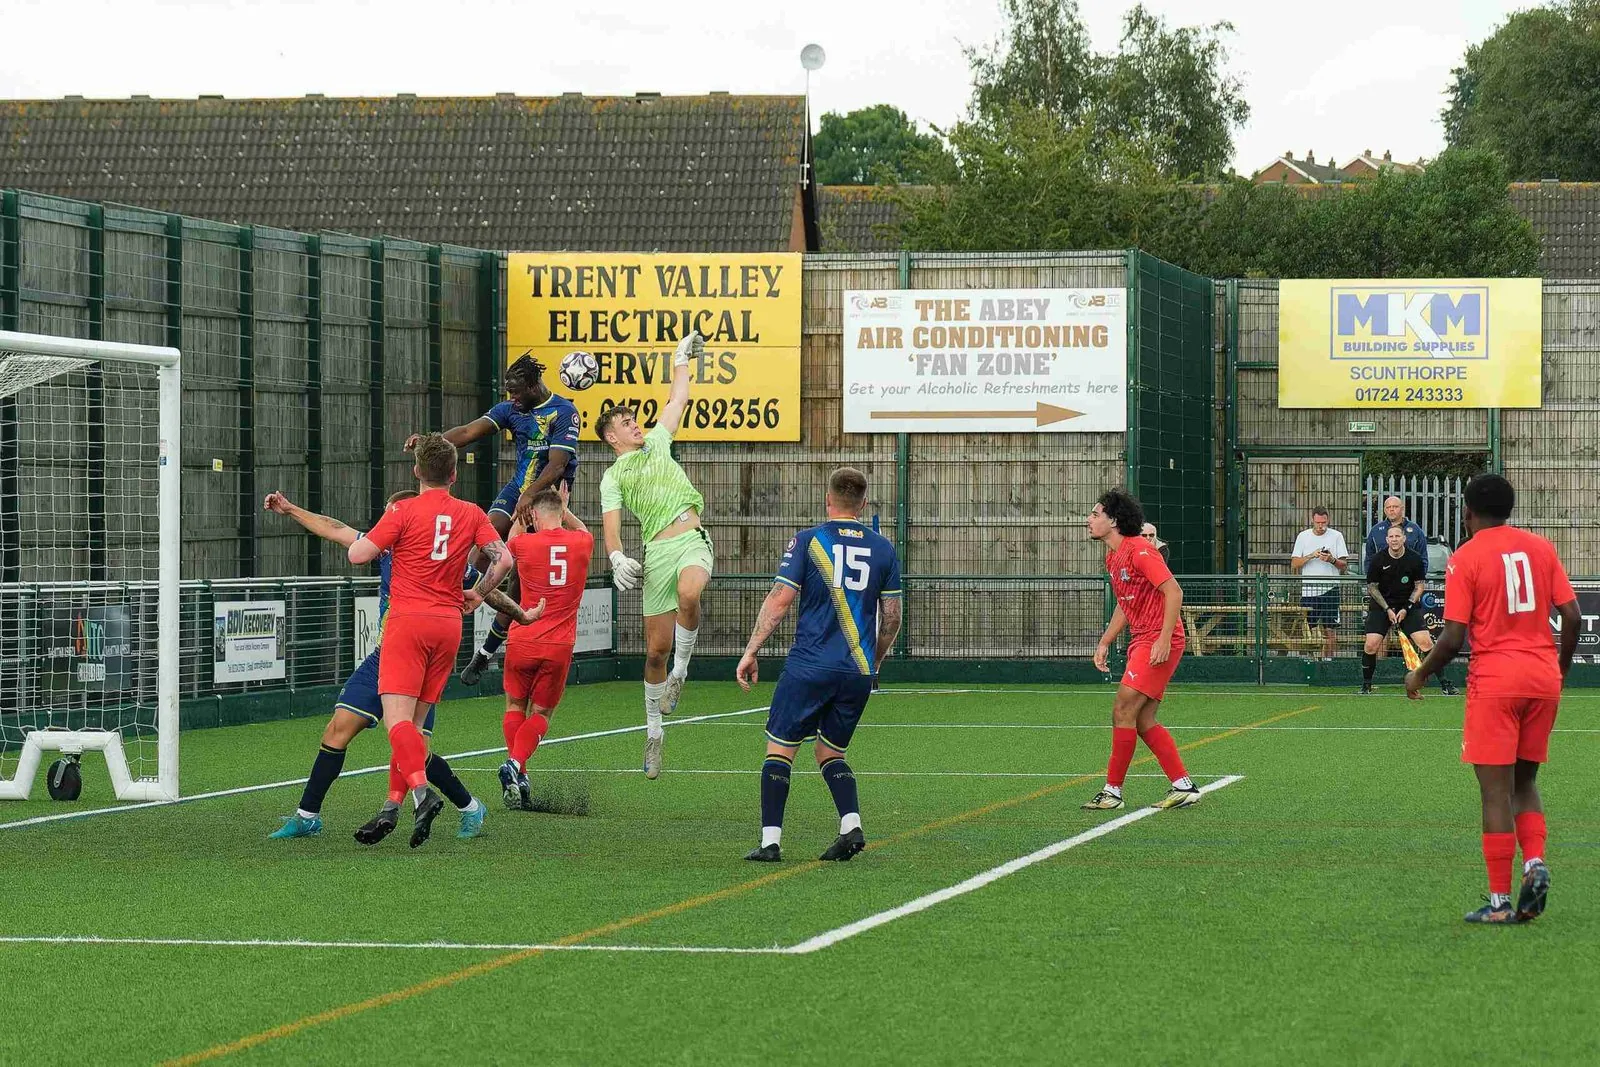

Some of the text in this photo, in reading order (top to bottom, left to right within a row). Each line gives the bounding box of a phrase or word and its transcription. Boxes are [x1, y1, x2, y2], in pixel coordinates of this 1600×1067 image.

[527, 264, 783, 298] TRENT VALLEY
[548, 309, 759, 343] ELECTRICAL
[915, 298, 1050, 322] THE ABEY
[1337, 293, 1481, 358] MKM
[857, 325, 1108, 349] AIR CONDITIONING
[1343, 341, 1475, 352] BUILDING SUPPLIES
[593, 351, 737, 384] ERVIES
[1350, 366, 1467, 380] SCUNTHORPE
[848, 381, 1118, 398] Get your Alcoholic Refreshments here
[1355, 388, 1463, 402] 01724 243333
[683, 397, 780, 429] 782356
[430, 514, 453, 561] 6
[549, 545, 567, 586] 5
[832, 544, 872, 591] 15
[1501, 551, 1536, 615] 10
[243, 613, 275, 633] RECOVERY
